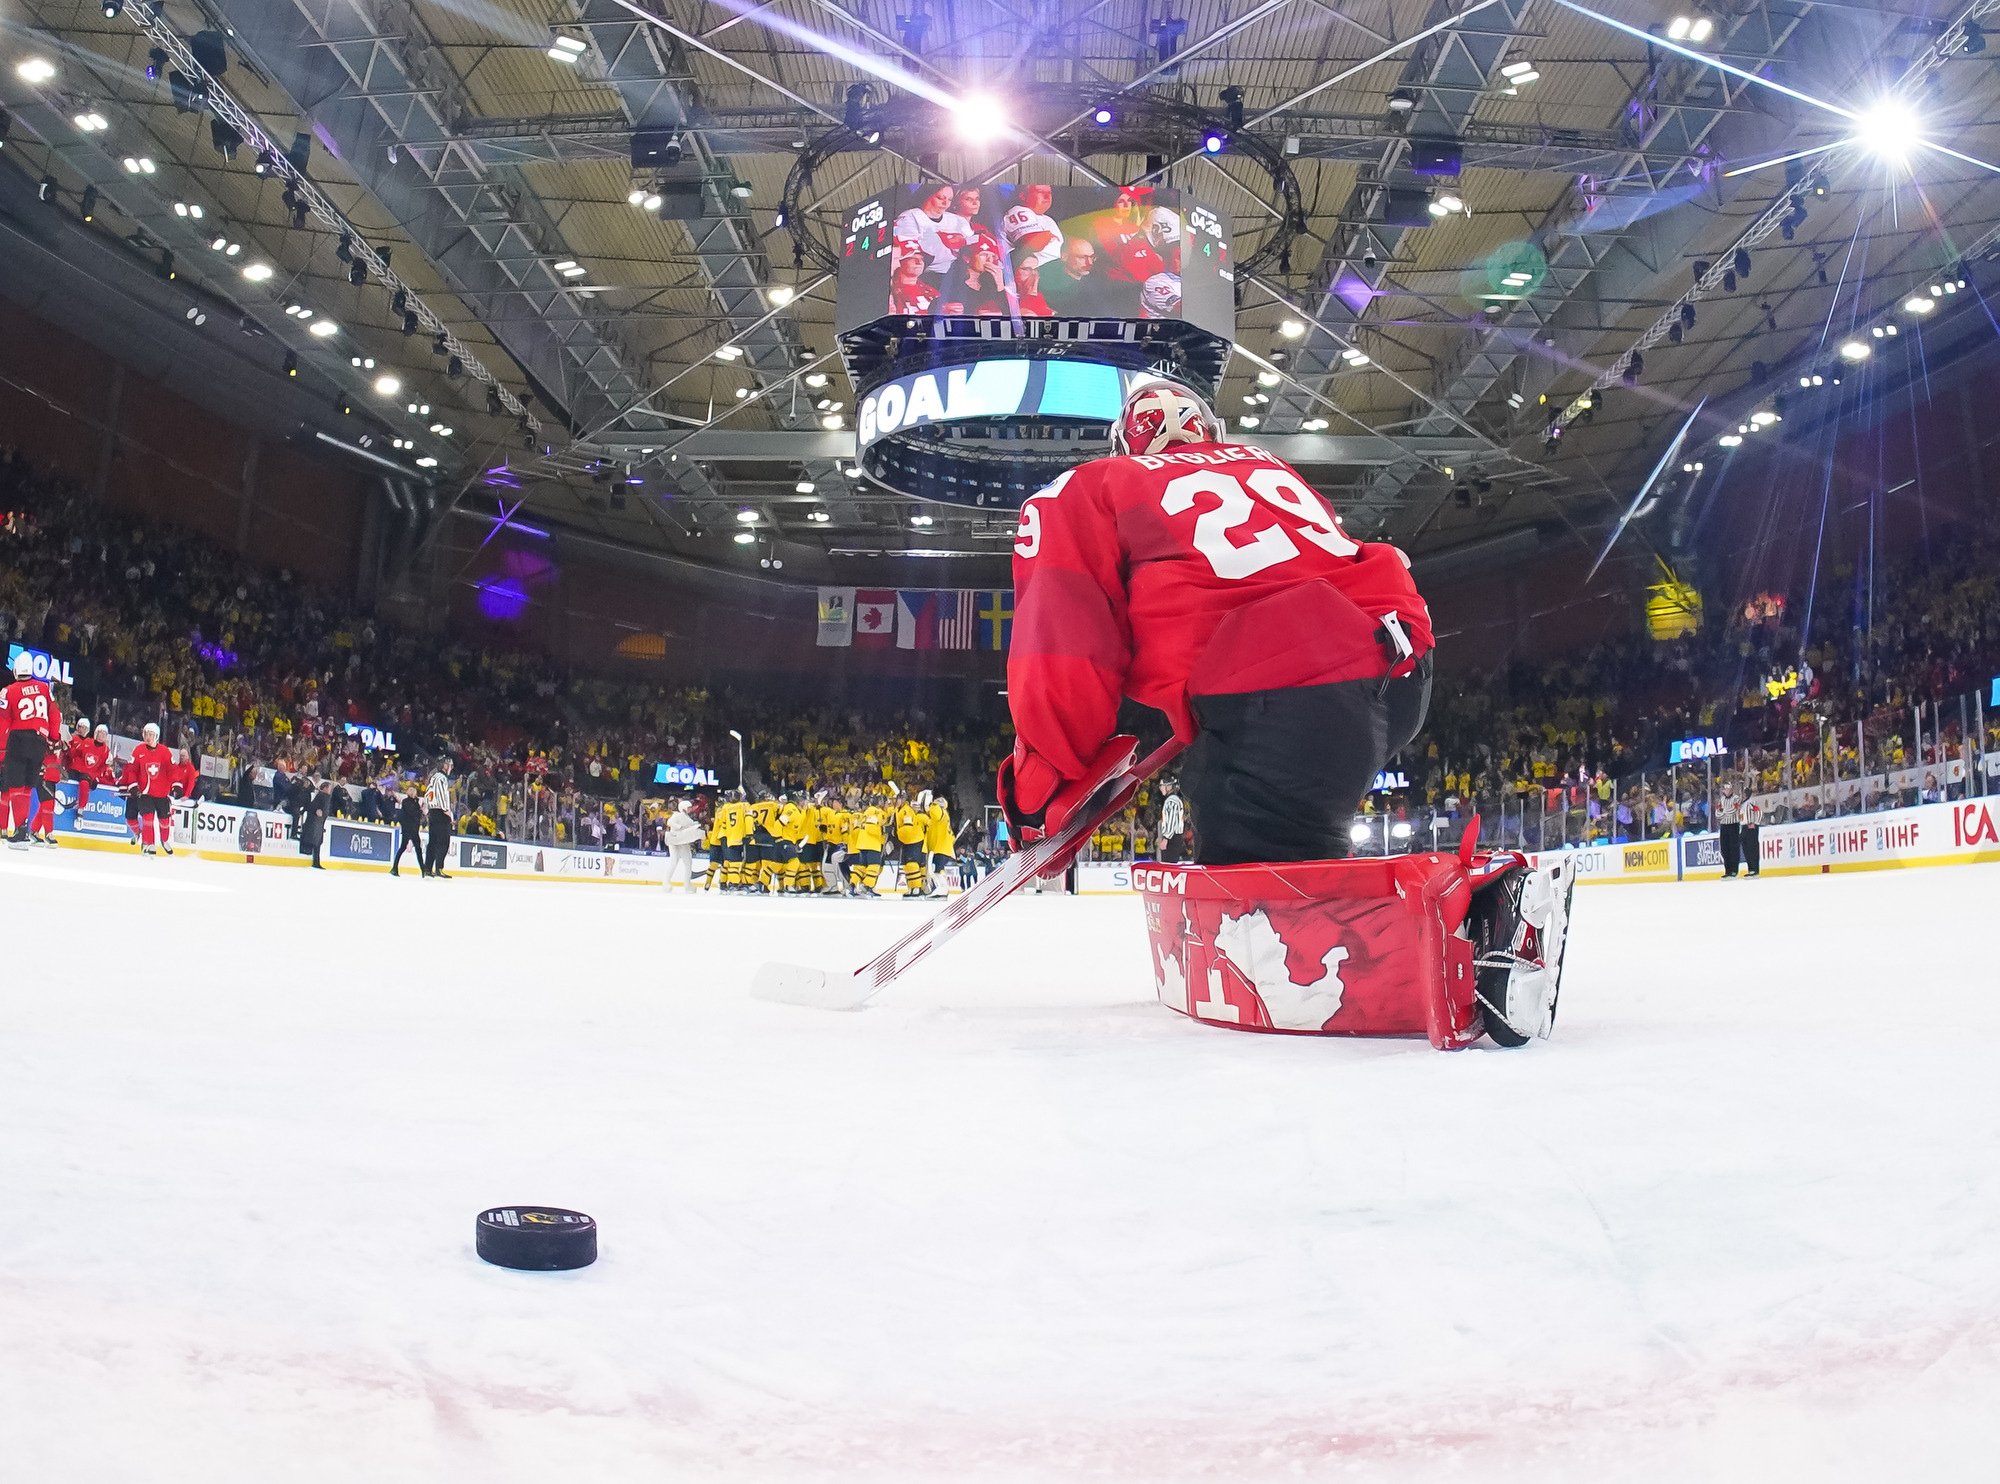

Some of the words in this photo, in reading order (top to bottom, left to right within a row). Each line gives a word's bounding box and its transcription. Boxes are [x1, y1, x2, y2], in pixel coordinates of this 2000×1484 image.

[852, 207, 883, 232] 04:38
[1191, 212, 1222, 238] 04:38
[862, 236, 870, 250] 4
[878, 228, 886, 242] 2
[846, 242, 854, 256] 2
[1203, 243, 1211, 256] 4
[1219, 249, 1227, 262] 2
[860, 369, 984, 445] GOAL
[1160, 469, 1360, 580] 29
[33, 655, 74, 685] OAL
[18, 695, 48, 721] 28
[1680, 737, 1728, 760] GOAL
[666, 767, 719, 785] GOAL
[1373, 772, 1409, 789] OAL
[97, 801, 123, 817] College
[729, 812, 737, 827] 5
[1953, 803, 1999, 847] ICA
[361, 836, 373, 850] BFL
[1797, 834, 1825, 857] IIHF
[1838, 829, 1868, 853] IIHF
[1885, 823, 1919, 849] IIHF
[1762, 839, 1783, 859] IHF
[573, 857, 600, 870] TELUS
[1577, 853, 1606, 872] SOTI
[1134, 869, 1187, 895] CCM
